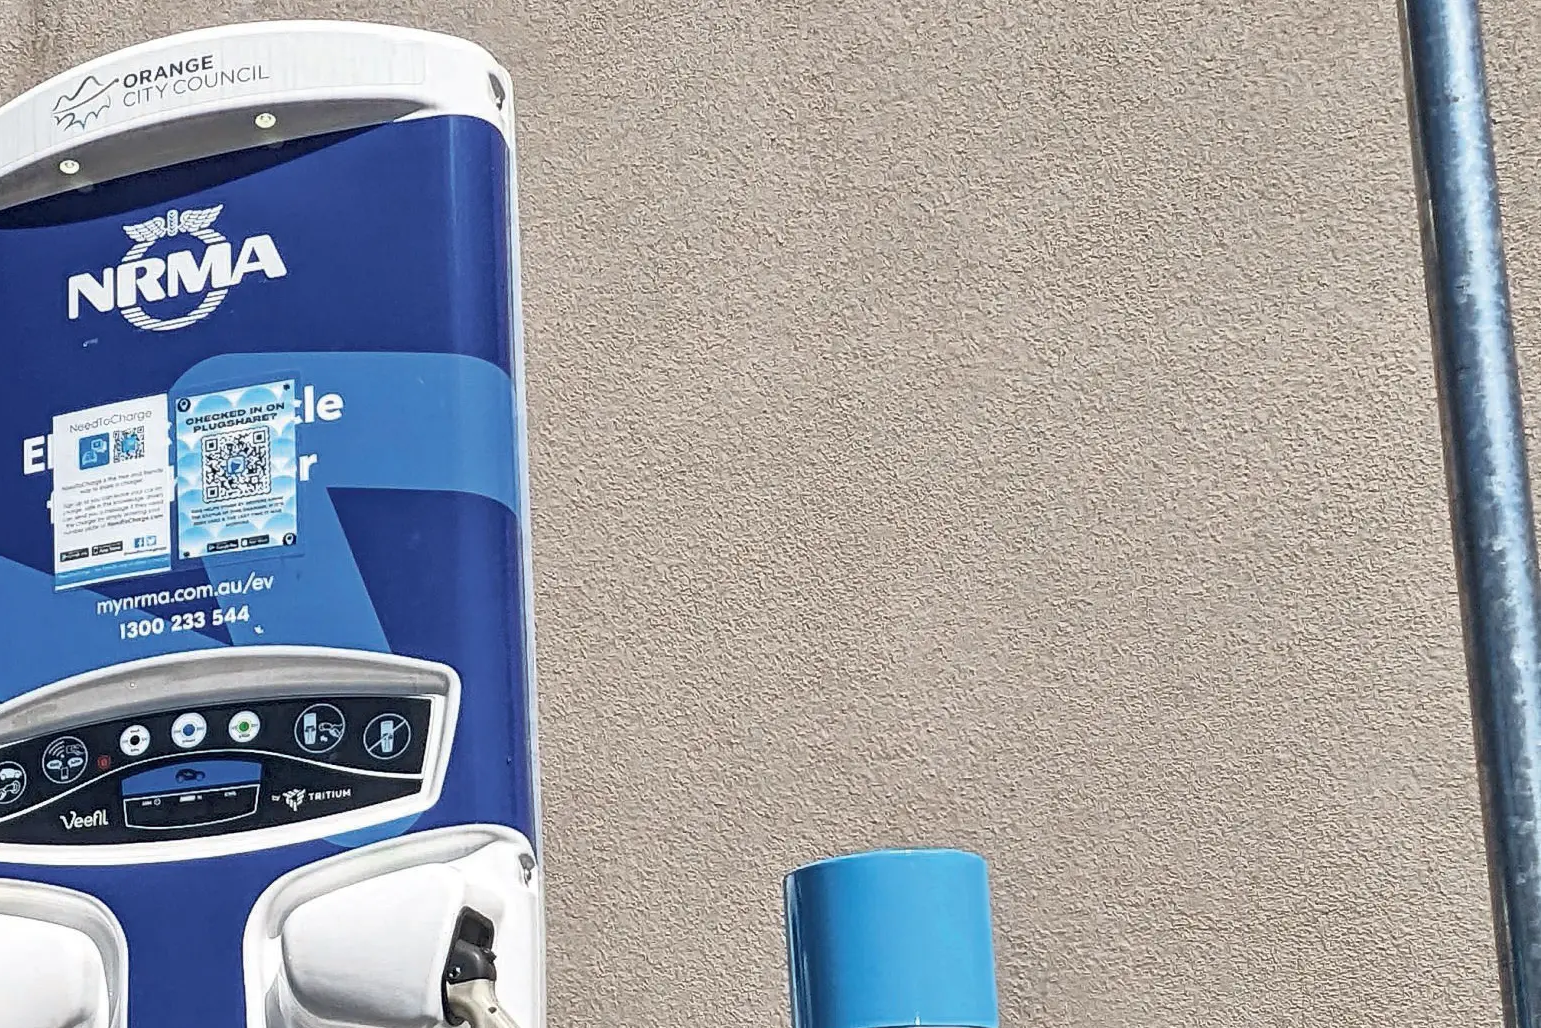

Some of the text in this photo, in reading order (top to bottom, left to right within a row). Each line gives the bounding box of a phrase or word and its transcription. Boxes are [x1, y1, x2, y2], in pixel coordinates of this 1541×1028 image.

[123, 55, 214, 88] ORANGE
[123, 65, 269, 107] CITY COUNCIL
[68, 234, 287, 320] NRMA
[69, 409, 152, 433] NeedToCharge
[186, 402, 285, 425] CHECKED IN ON
[193, 413, 277, 433] PLUGSHARE?
[96, 572, 274, 615] mynrma.com.au/ev
[120, 605, 250, 639] 1300 233 544
[308, 788, 352, 802] TRITIUM
